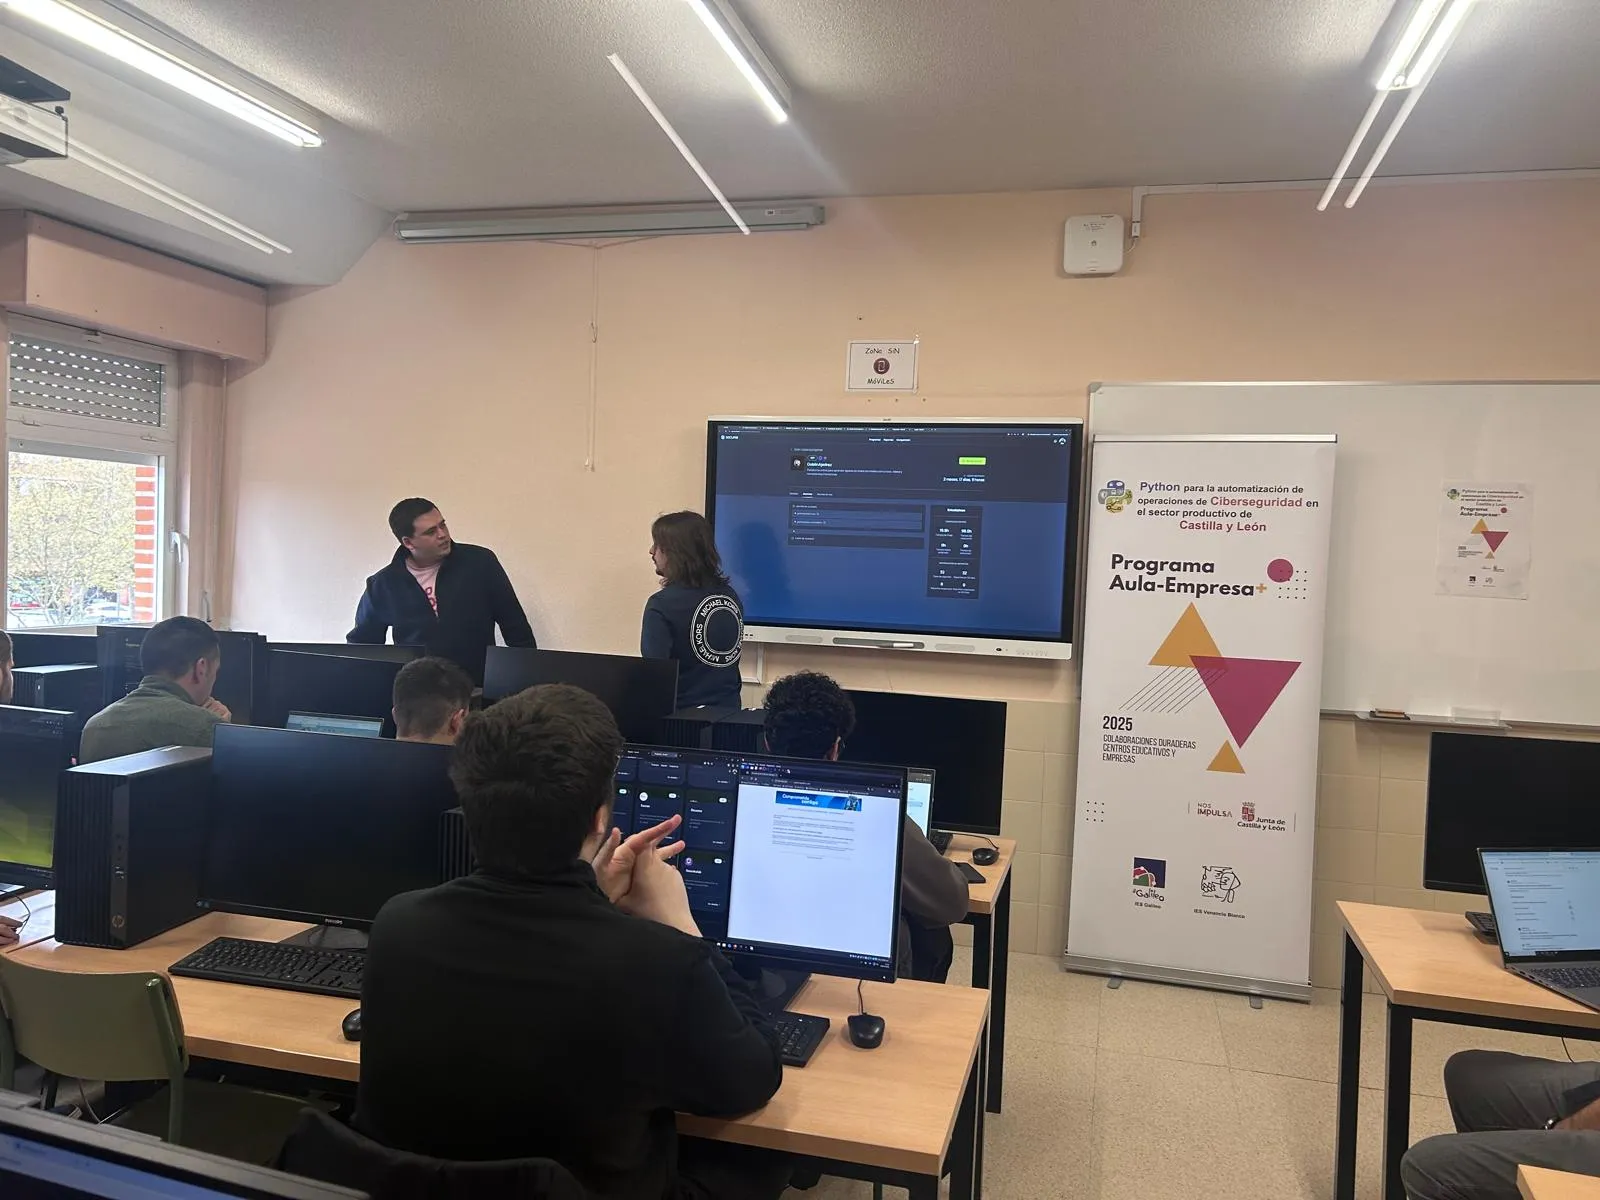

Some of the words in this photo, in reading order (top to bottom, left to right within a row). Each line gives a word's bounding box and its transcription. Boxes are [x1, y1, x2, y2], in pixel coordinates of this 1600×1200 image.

[1140, 482, 1180, 493] Python
[1207, 484, 1215, 492] la
[1217, 485, 1289, 493] automatización
[1292, 485, 1304, 493] de
[1137, 498, 1193, 506] operaciones
[1196, 498, 1207, 506] de
[1210, 496, 1303, 508] Ciberseguridad
[1306, 500, 1319, 508] en
[1137, 508, 1146, 516] el
[1148, 508, 1180, 517] sector
[1182, 509, 1237, 518] productivo
[1239, 510, 1252, 518] de
[1179, 520, 1223, 531] Castilla
[1225, 523, 1234, 532] y
[1237, 521, 1267, 532] León
[1111, 553, 1215, 575] Programa
[700, 599, 724, 617] MICHAEL
[723, 600, 739, 614] KORS
[695, 623, 704, 645] KORS
[1102, 715, 1133, 731] 2025
[1103, 734, 1157, 746] COLABORACIONES
[1158, 738, 1196, 749] DURADERAS
[1102, 743, 1131, 754] CENTROS
[1132, 745, 1170, 757] EDUCATIVOS
[1171, 749, 1176, 757] Y
[1102, 753, 1136, 764] EMPRESAS
[1197, 808, 1233, 818] IMPULSA
[1237, 821, 1261, 829] Castilla
[1268, 824, 1286, 832] León
